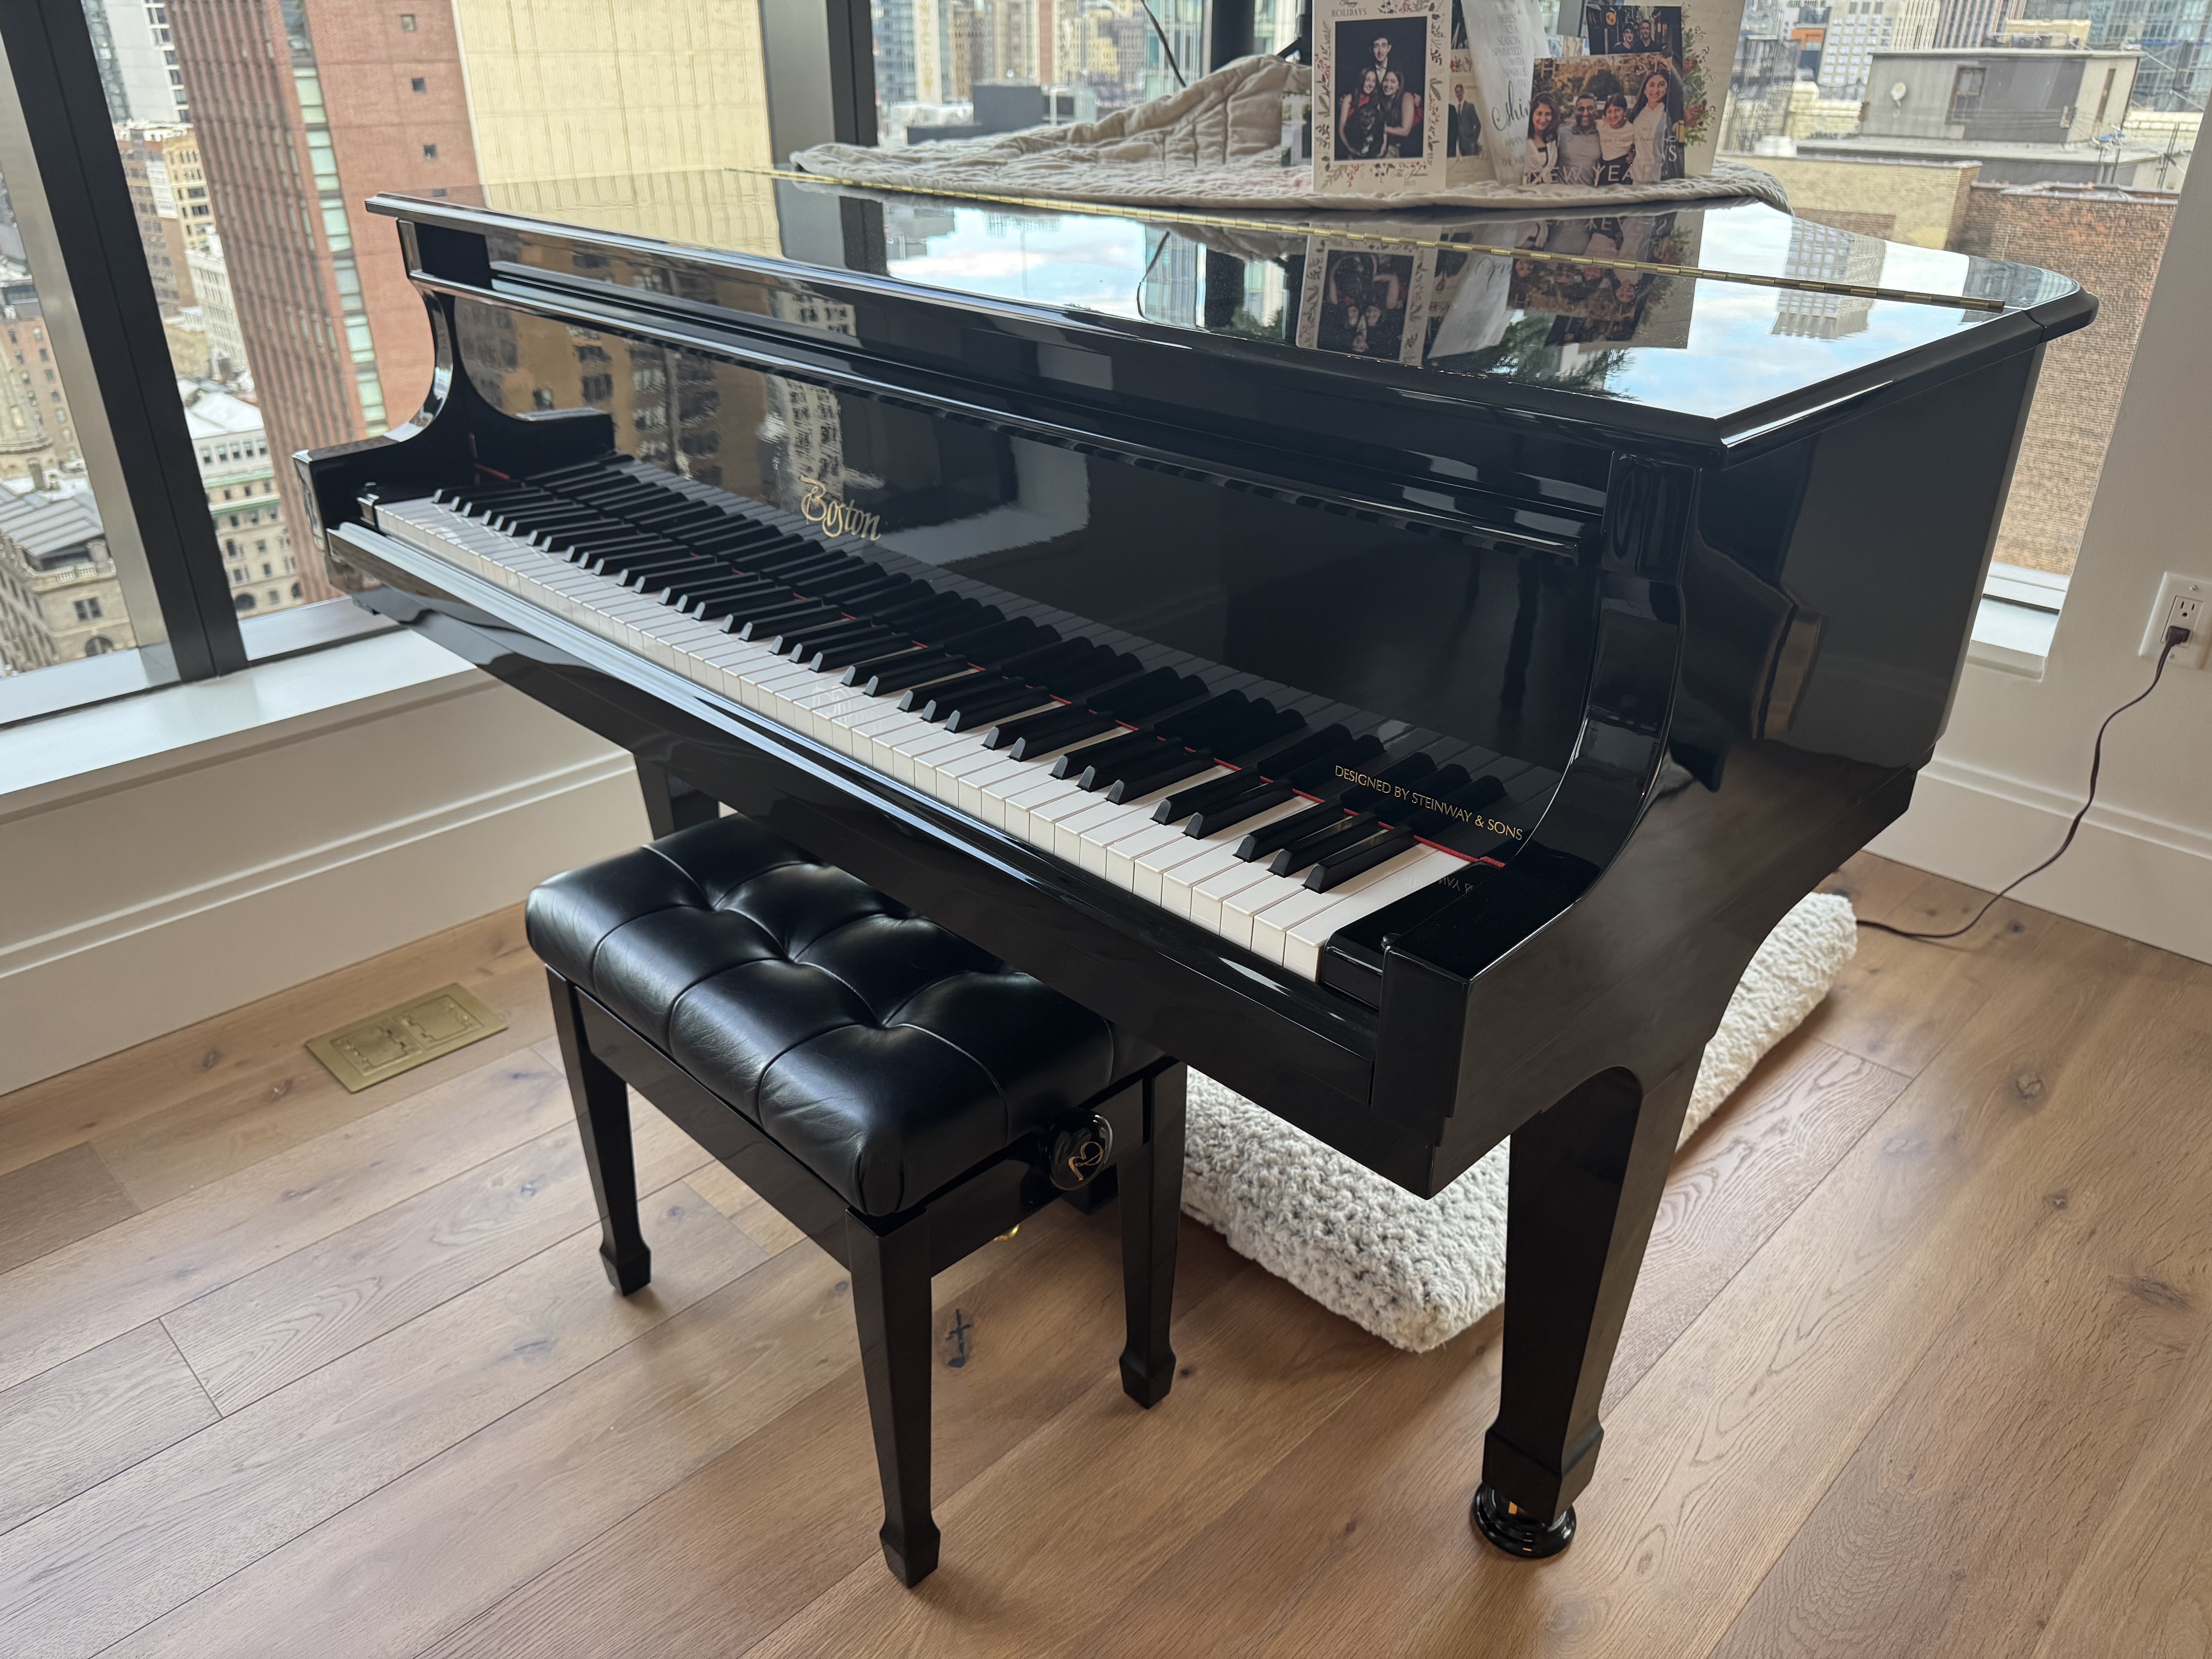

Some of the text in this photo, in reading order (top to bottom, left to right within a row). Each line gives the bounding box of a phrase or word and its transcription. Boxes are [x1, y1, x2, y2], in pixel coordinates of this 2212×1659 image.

[1331, 8, 1367, 17] HOLIDAYS
[800, 474, 881, 541] Boston
[1335, 765, 1523, 840] DESIGNED BY STEINWAY & SONS
